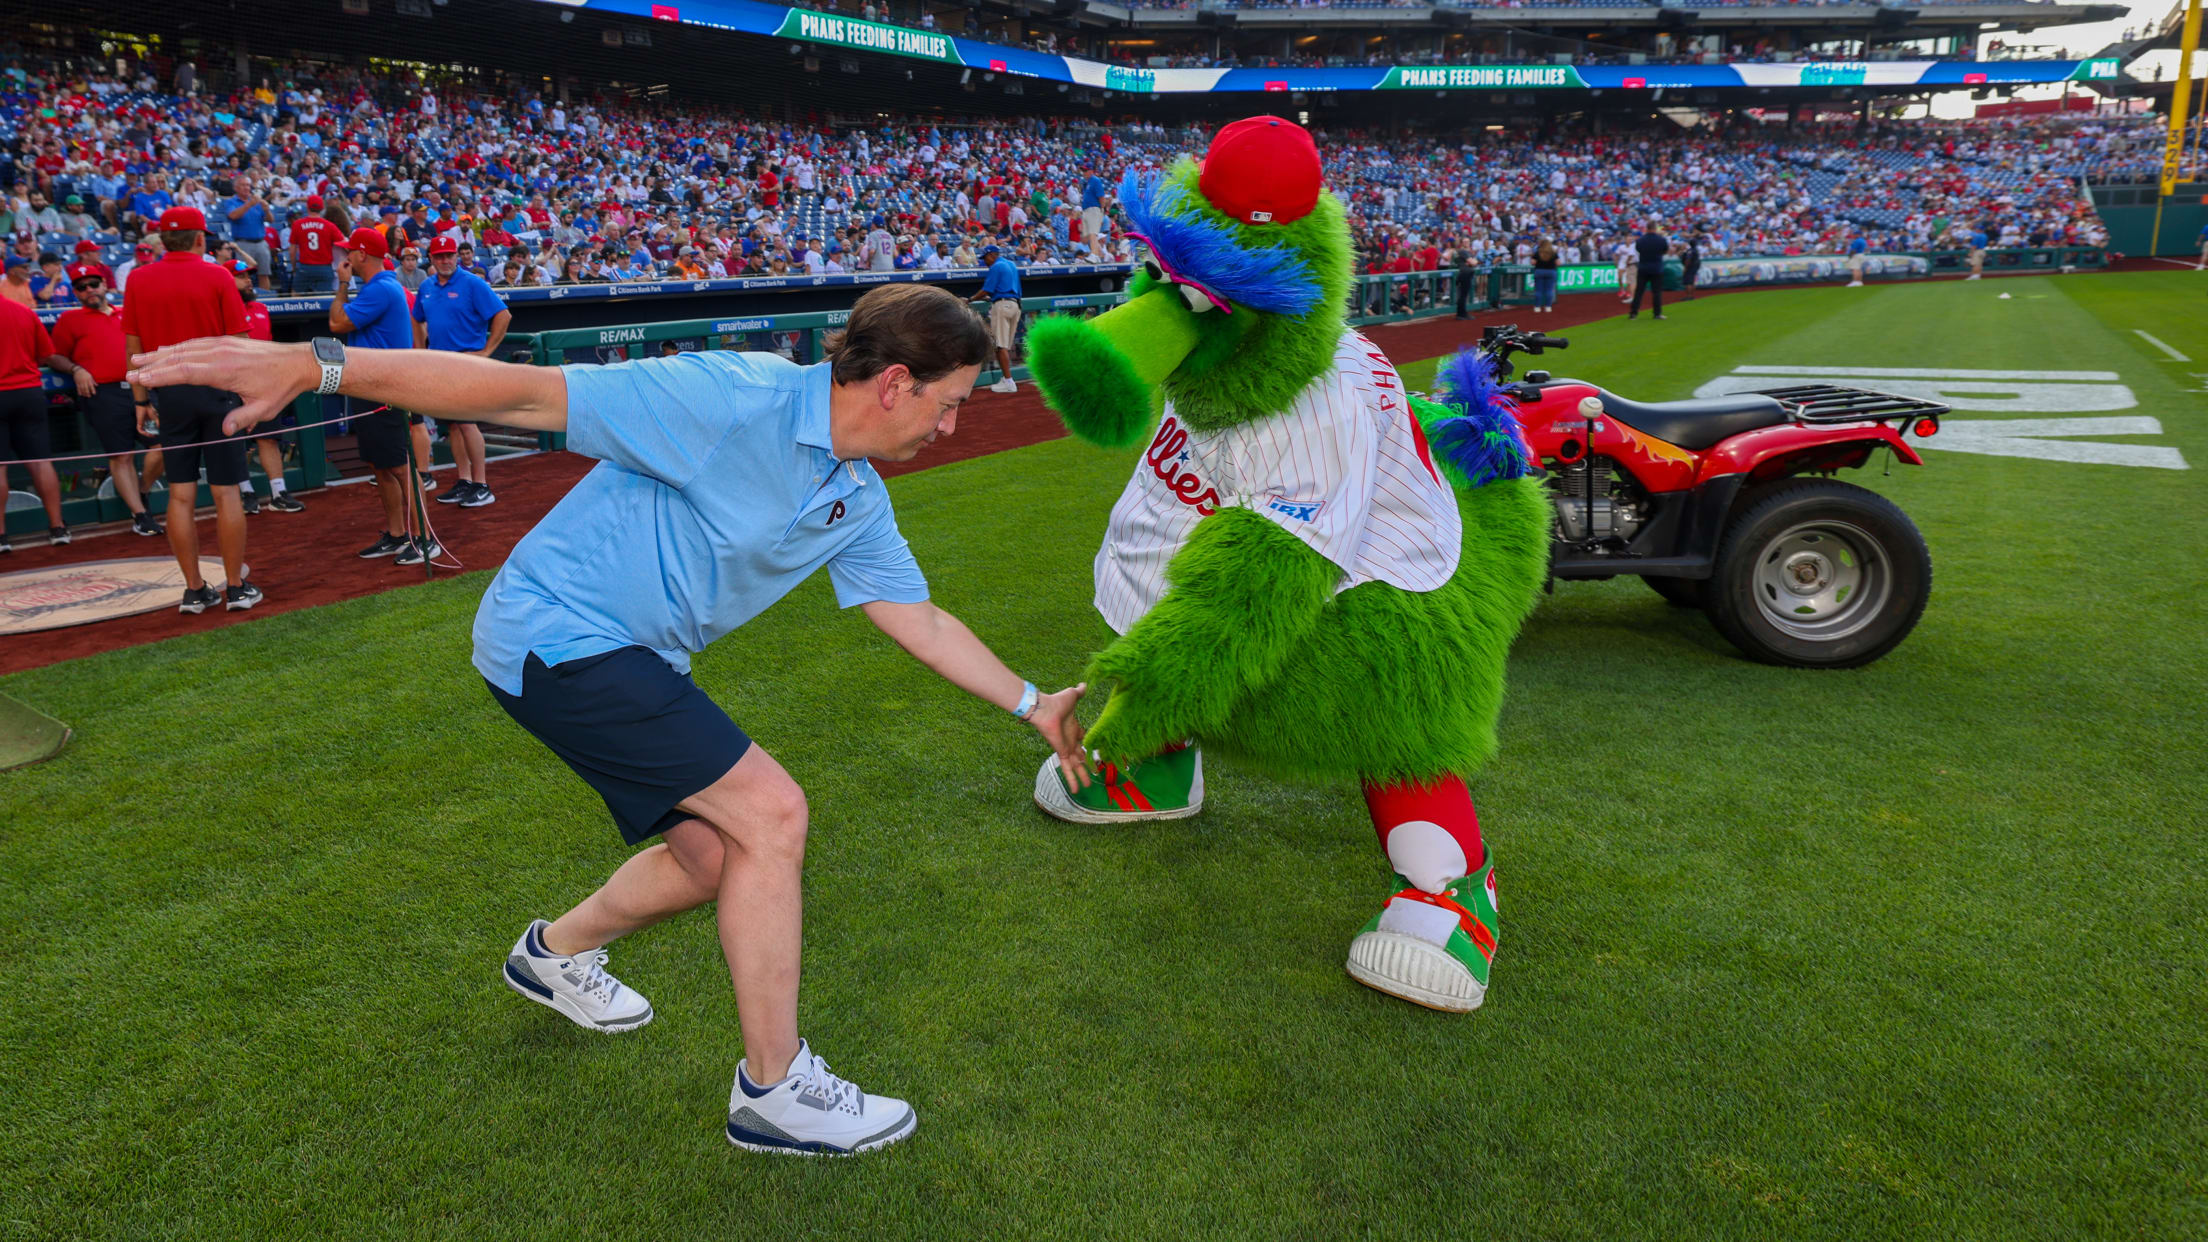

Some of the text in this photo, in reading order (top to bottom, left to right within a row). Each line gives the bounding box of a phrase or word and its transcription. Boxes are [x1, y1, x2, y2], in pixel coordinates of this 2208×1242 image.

[801, 13, 947, 58] PHANS FEEDING FAMILIES
[1401, 68, 1566, 87] PHANS FEEDING FAMILIES
[2166, 129, 2180, 182] 329
[307, 231, 319, 251] 3
[881, 241, 891, 255] 12
[284, 302, 303, 311] Bank
[304, 301, 320, 310] Park
[717, 320, 762, 332] smartwater
[600, 328, 645, 344] RE/MAX
[825, 499, 846, 527] P
